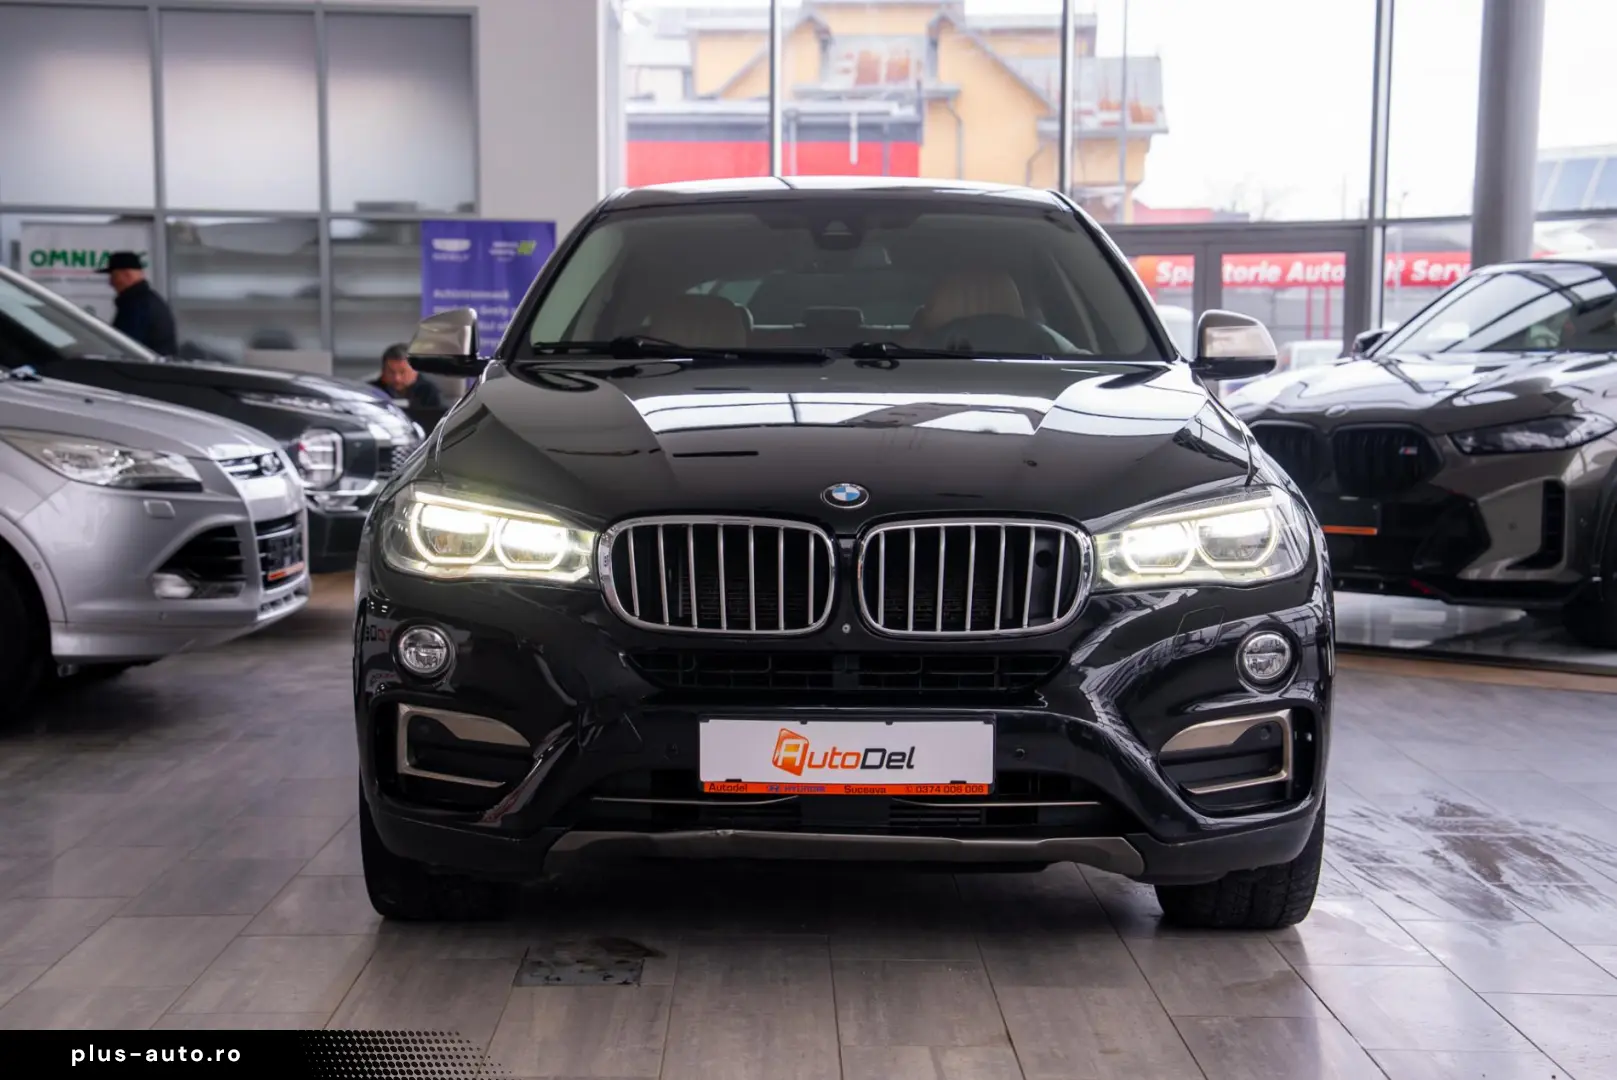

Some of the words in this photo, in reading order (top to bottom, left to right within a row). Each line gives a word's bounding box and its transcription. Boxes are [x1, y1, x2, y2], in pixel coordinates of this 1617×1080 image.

[1286, 261, 1346, 283] Auto
[777, 737, 915, 769] AutoDel
[708, 783, 747, 793] Autodel
[844, 784, 887, 794] Suceava
[915, 784, 940, 793] 0374
